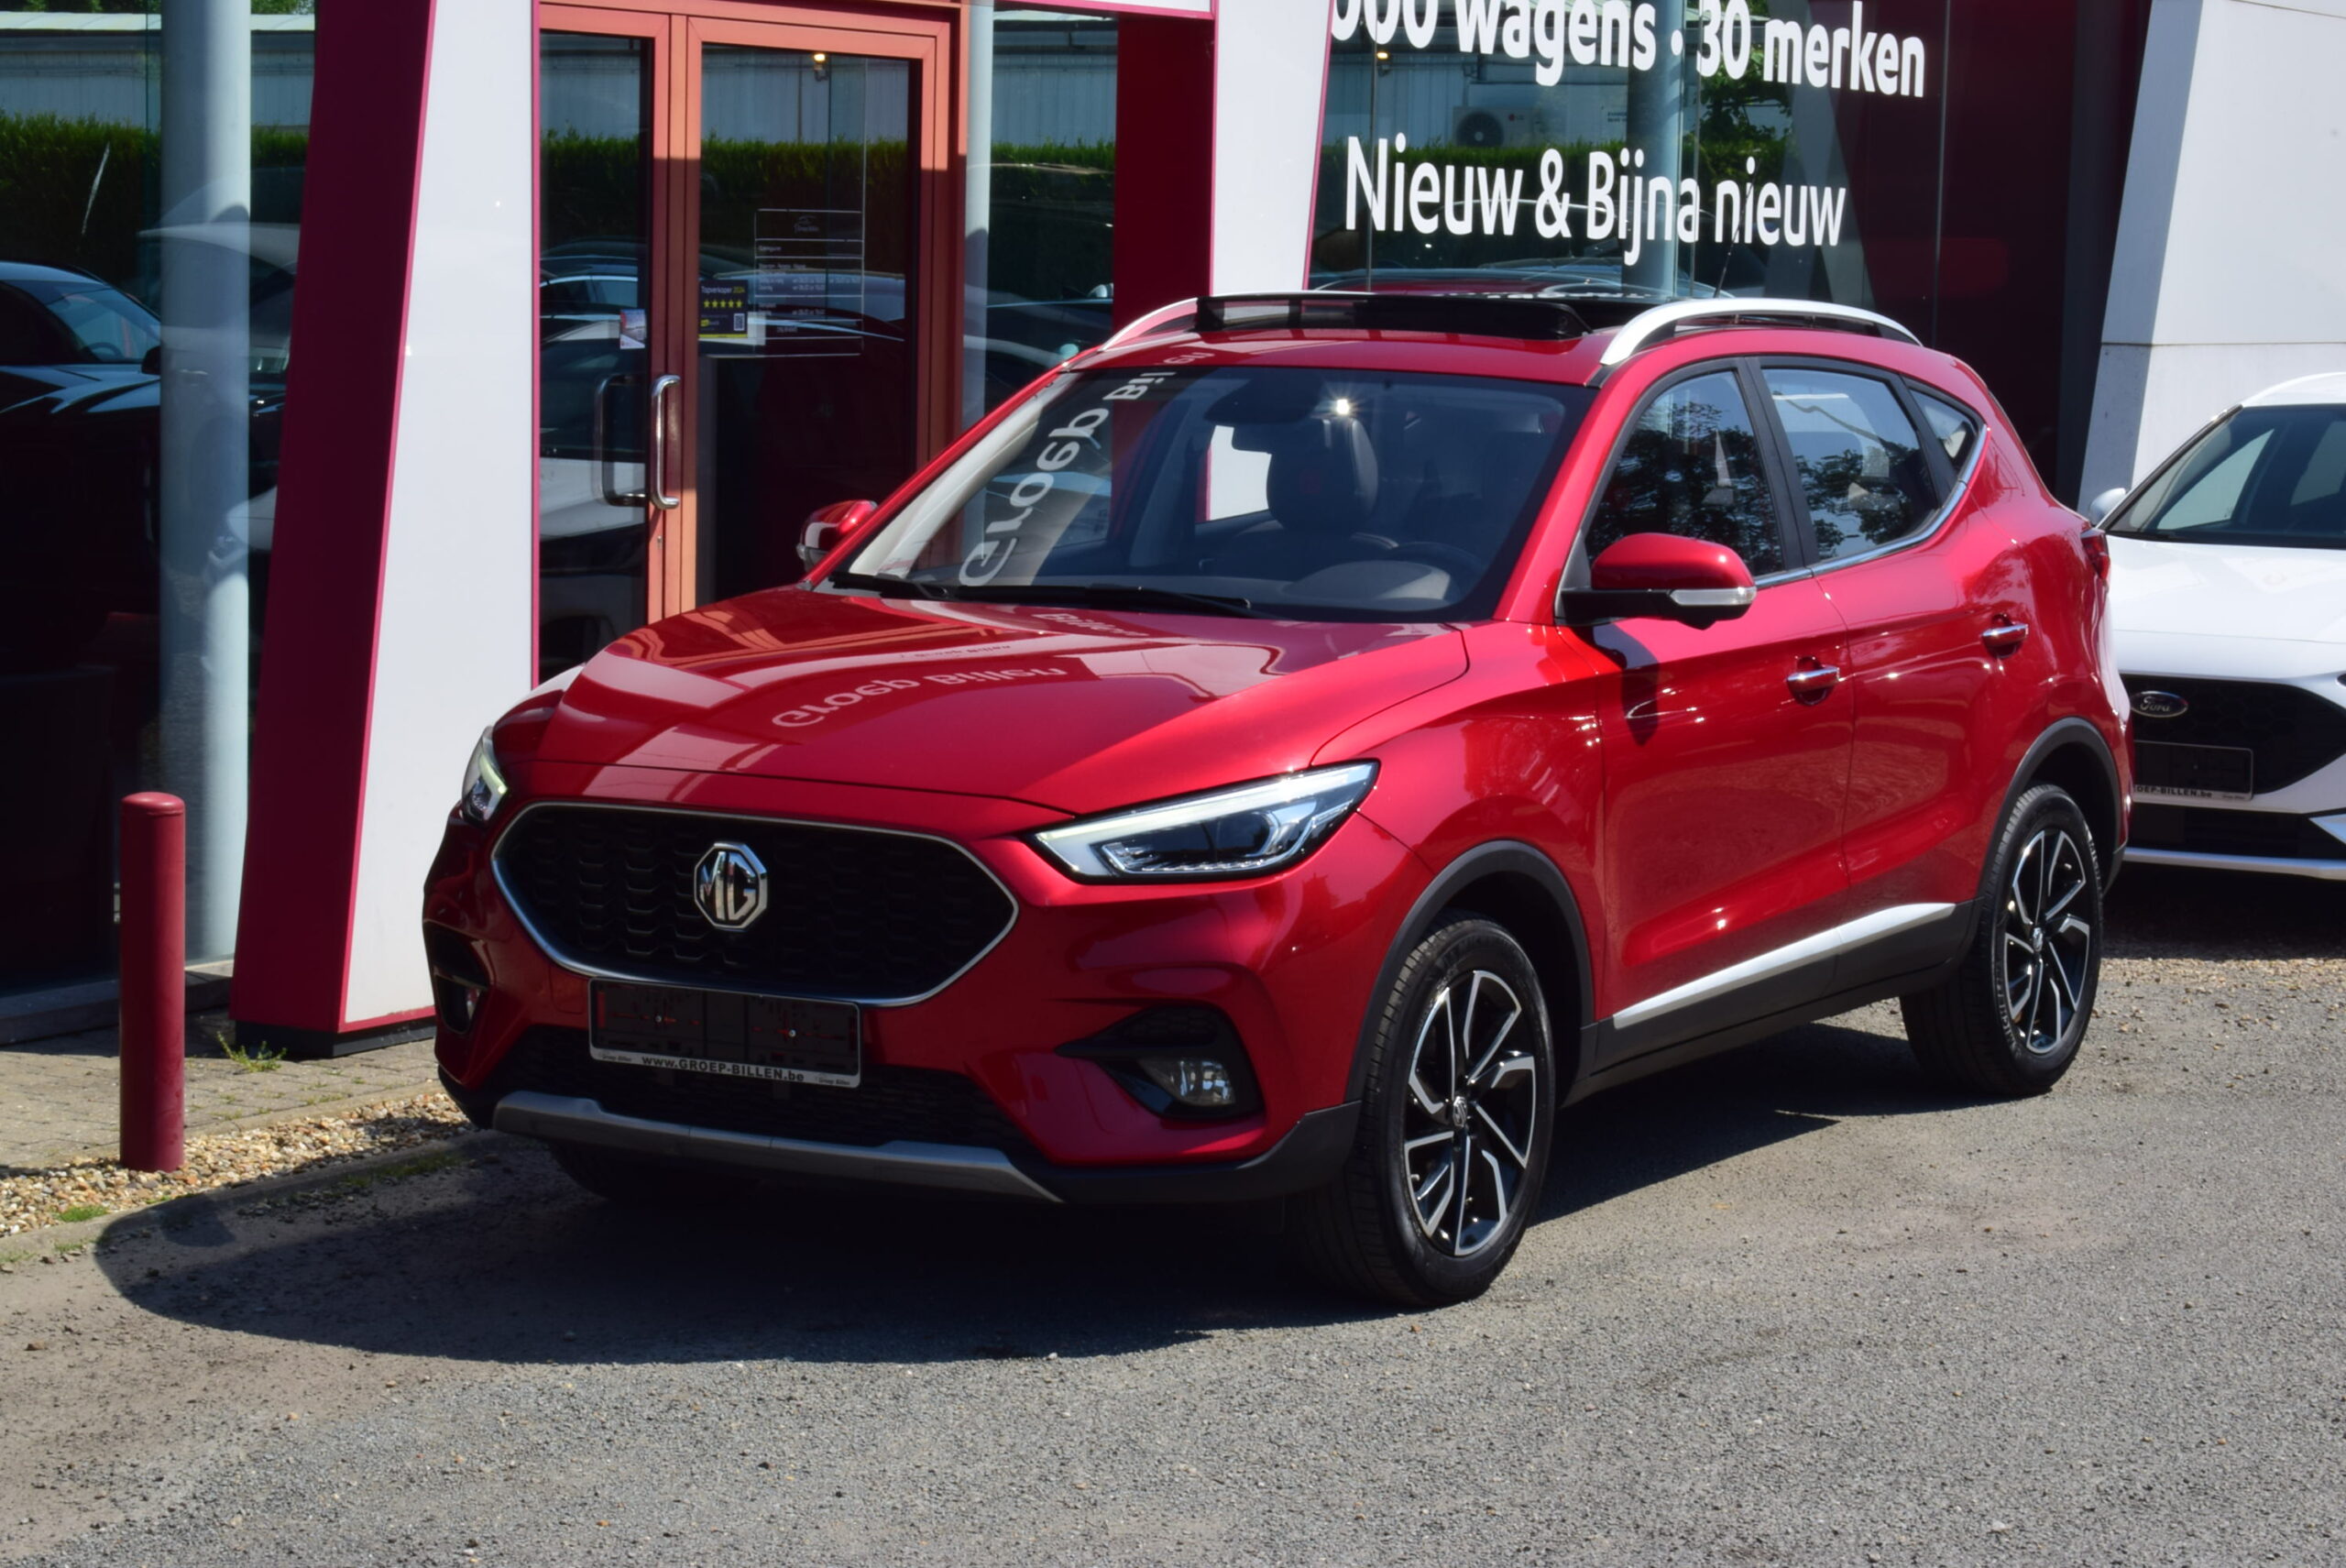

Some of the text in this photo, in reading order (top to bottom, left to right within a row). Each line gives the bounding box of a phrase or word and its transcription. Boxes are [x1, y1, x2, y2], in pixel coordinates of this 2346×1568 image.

[1455, 0, 1656, 86] wagens
[1697, 3, 1751, 80] 30
[1764, 0, 1926, 98] merken
[1345, 133, 1846, 266] Nieuw & Bijna nieuw
[699, 850, 756, 920] MG
[641, 1056, 805, 1082] www.GROEP-BILLEN.be
